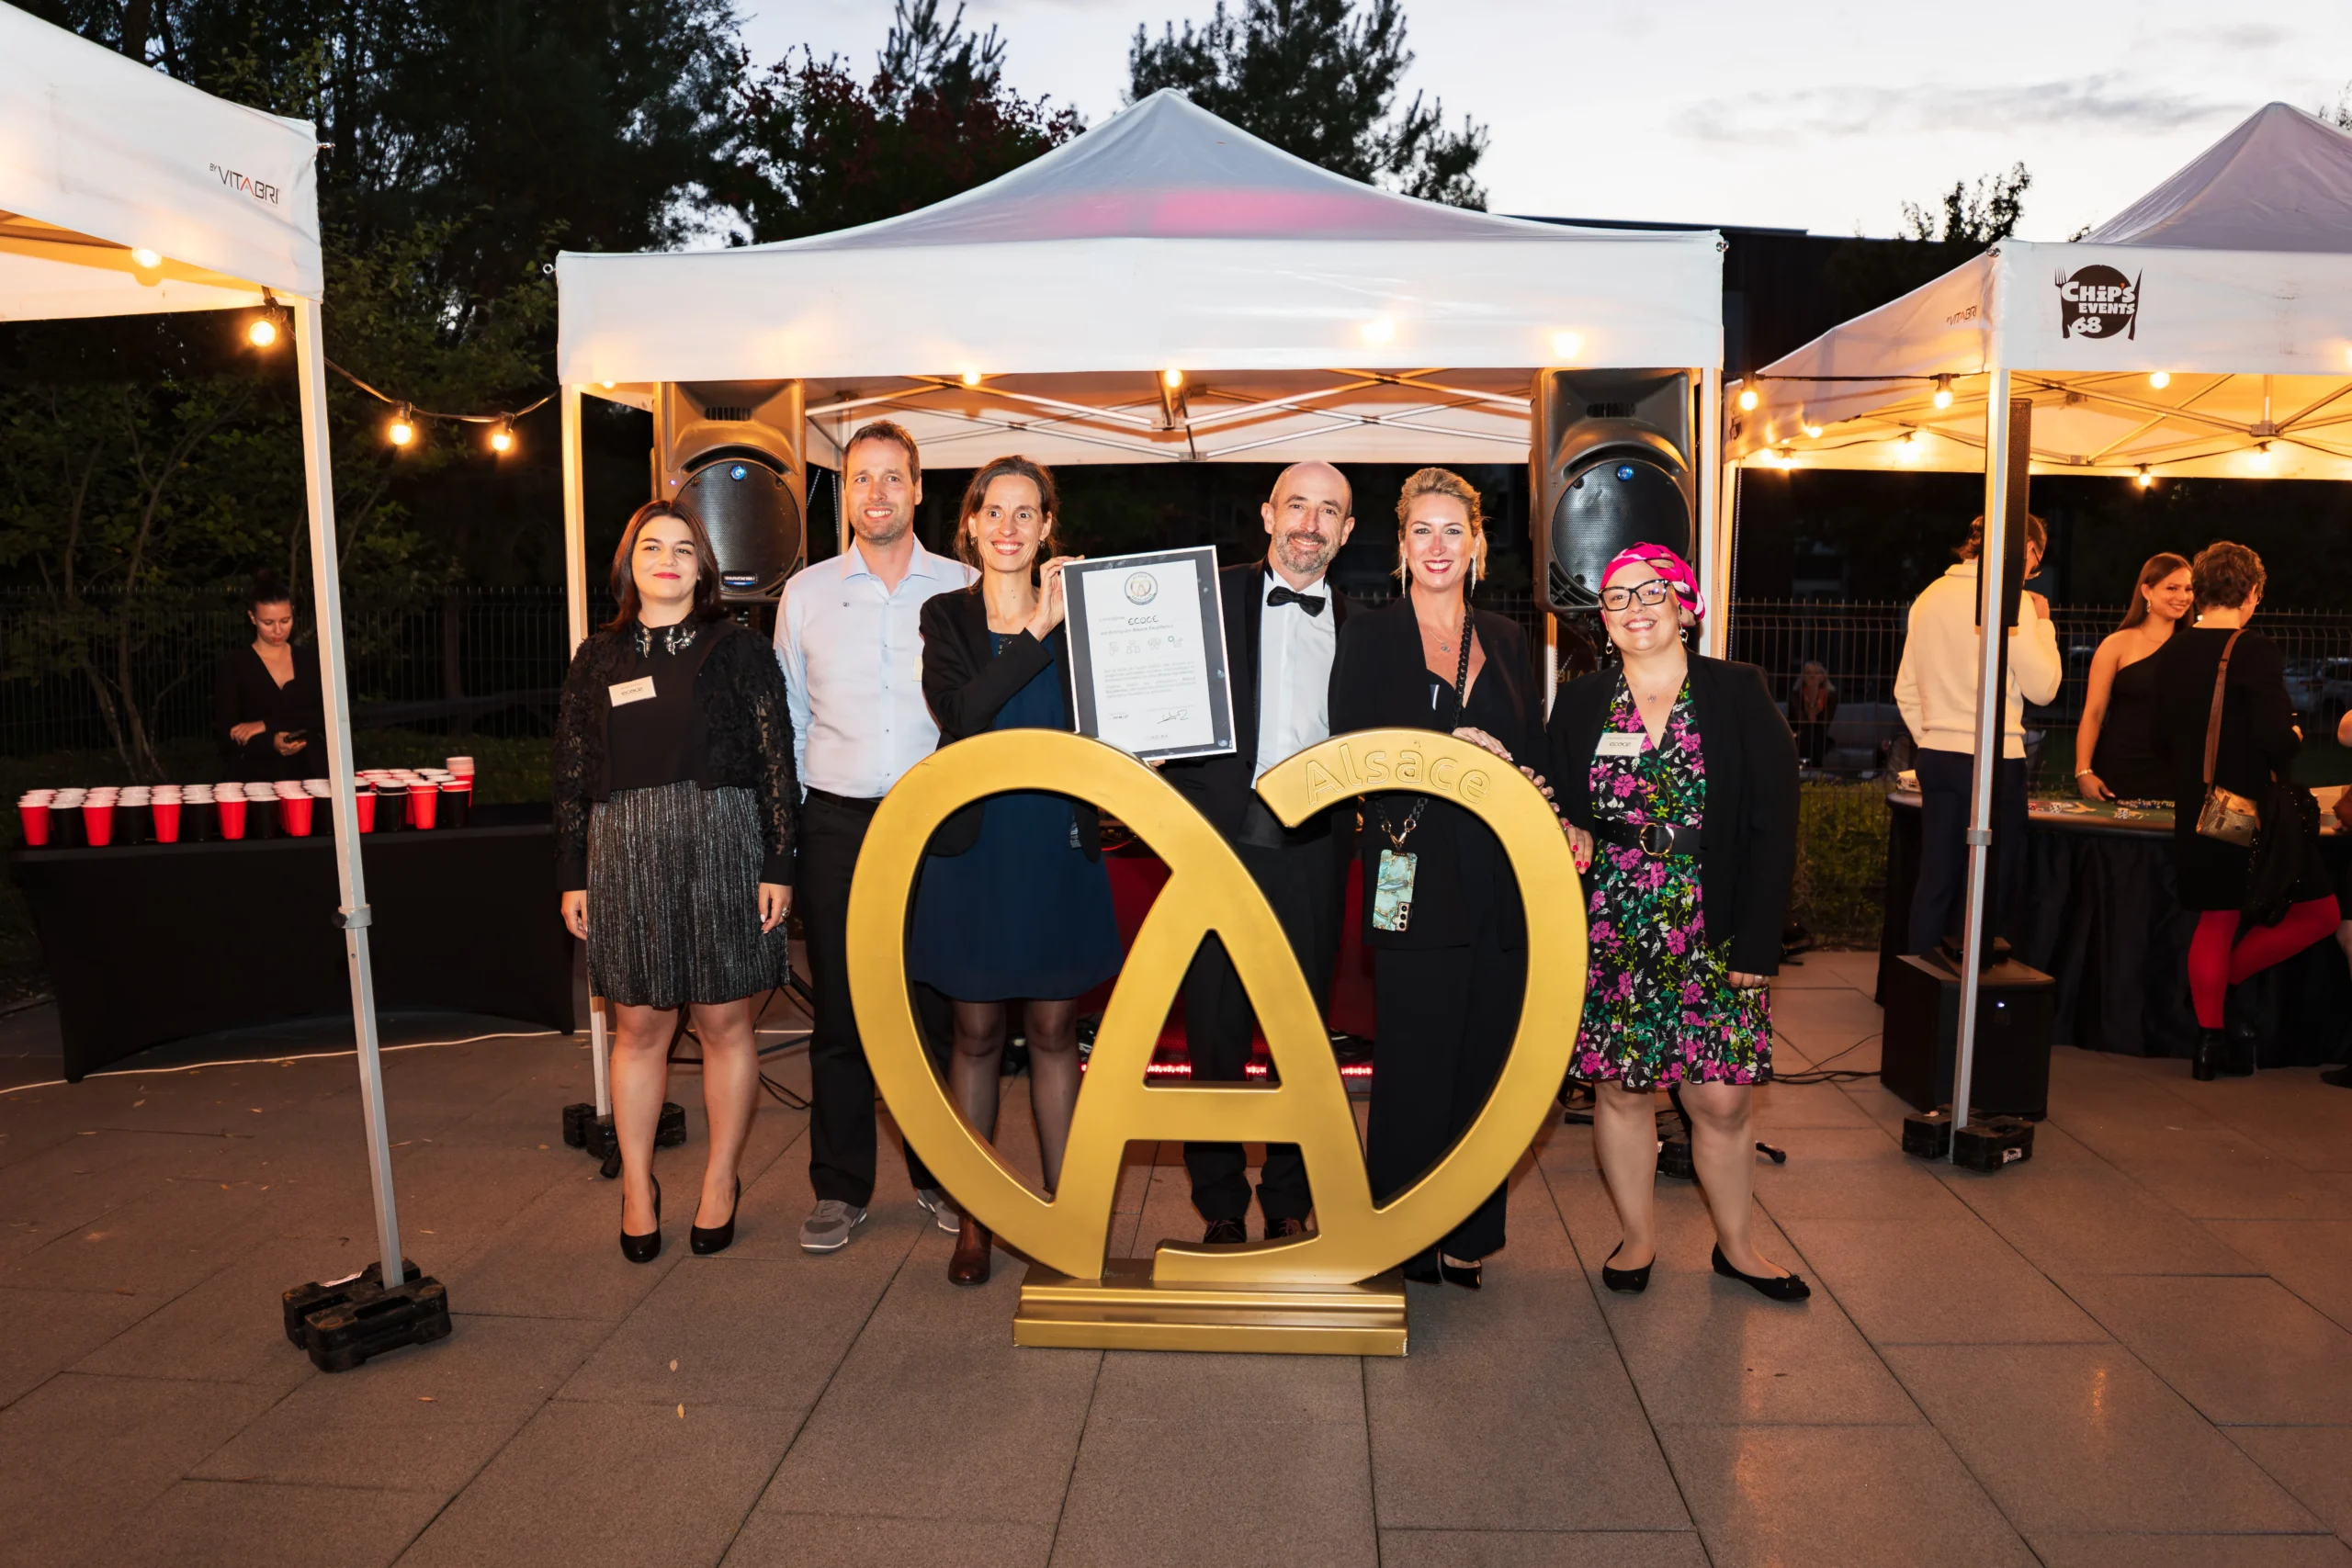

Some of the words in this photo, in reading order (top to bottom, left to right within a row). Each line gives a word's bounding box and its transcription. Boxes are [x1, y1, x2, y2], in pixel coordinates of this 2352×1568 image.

[209, 163, 218, 173] BY
[219, 166, 278, 204] VITABRI
[2078, 302, 2135, 315] EVENTS
[2071, 316, 2102, 333] 68
[1306, 742, 1491, 807] Alsace
